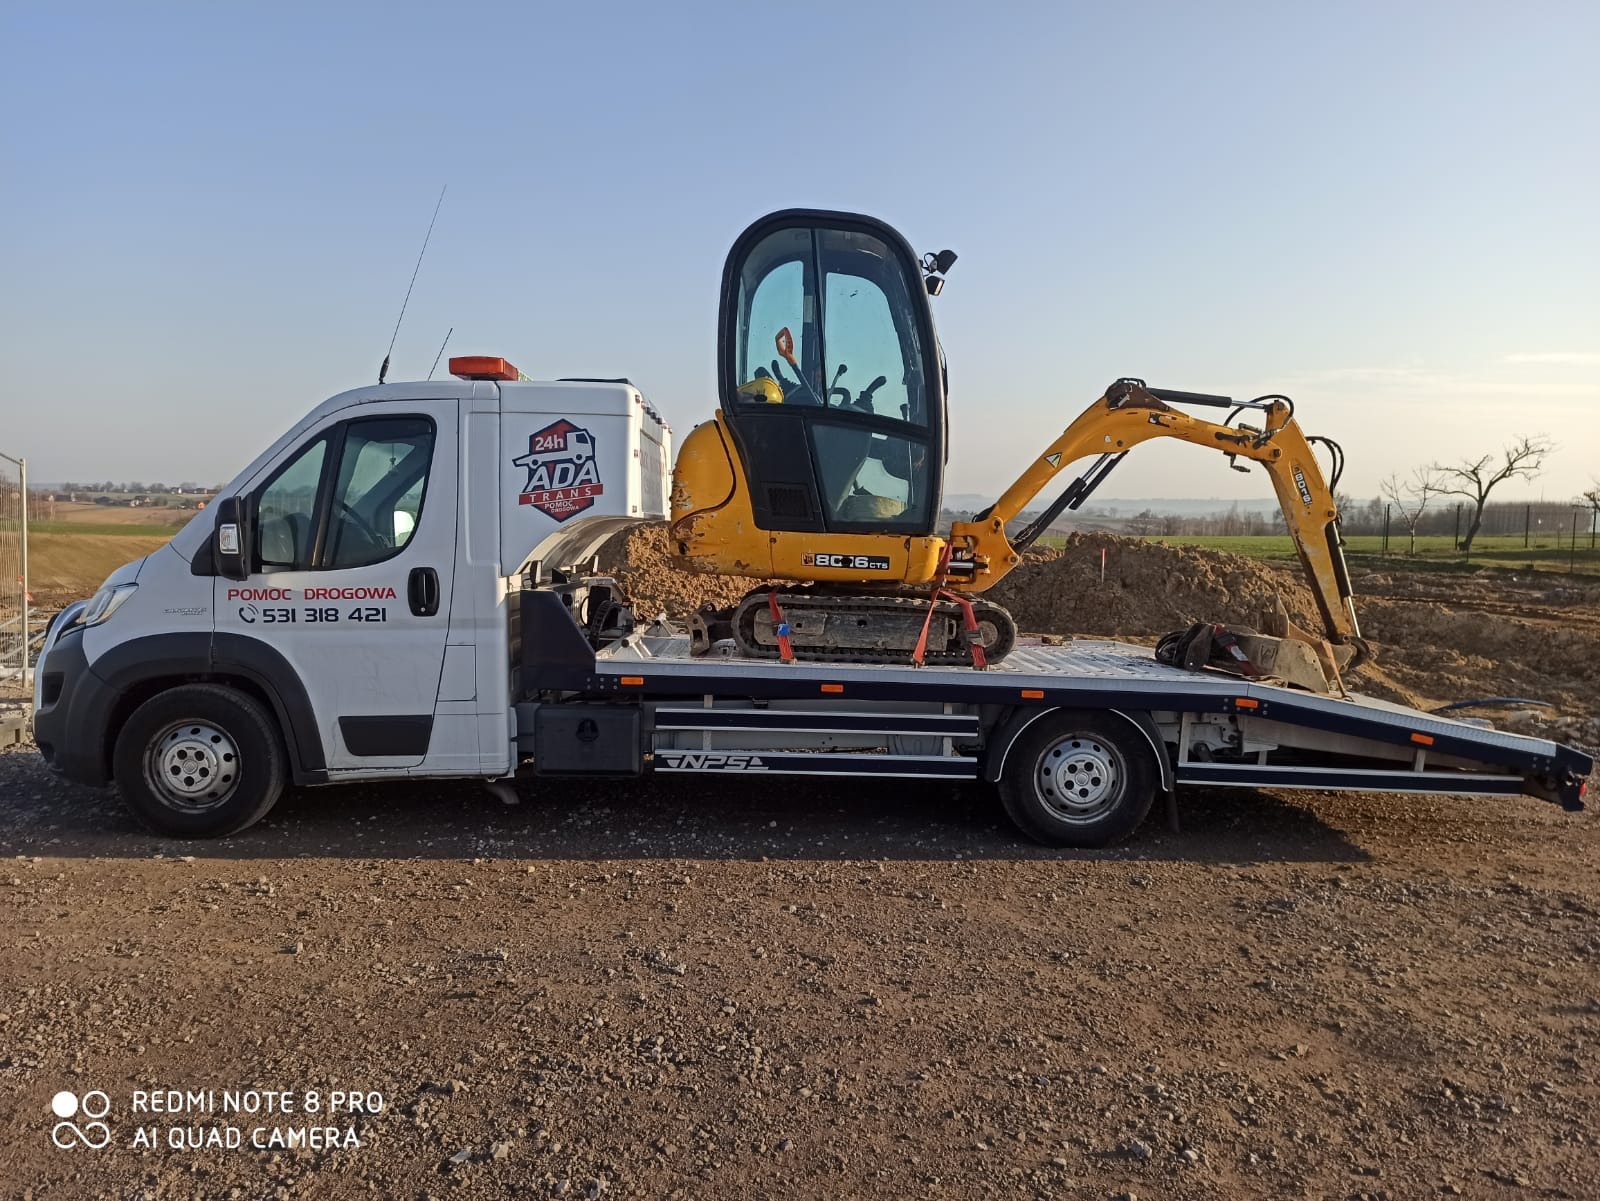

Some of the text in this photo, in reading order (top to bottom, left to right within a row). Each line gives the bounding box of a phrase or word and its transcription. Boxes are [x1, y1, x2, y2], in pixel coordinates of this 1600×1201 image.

[535, 434, 564, 451] 24h
[525, 459, 599, 493] ADA
[529, 486, 592, 503] TRANS
[544, 500, 573, 510] POMOC
[227, 587, 397, 601] POMOC DROGOWA
[262, 607, 387, 623] 531 318 421
